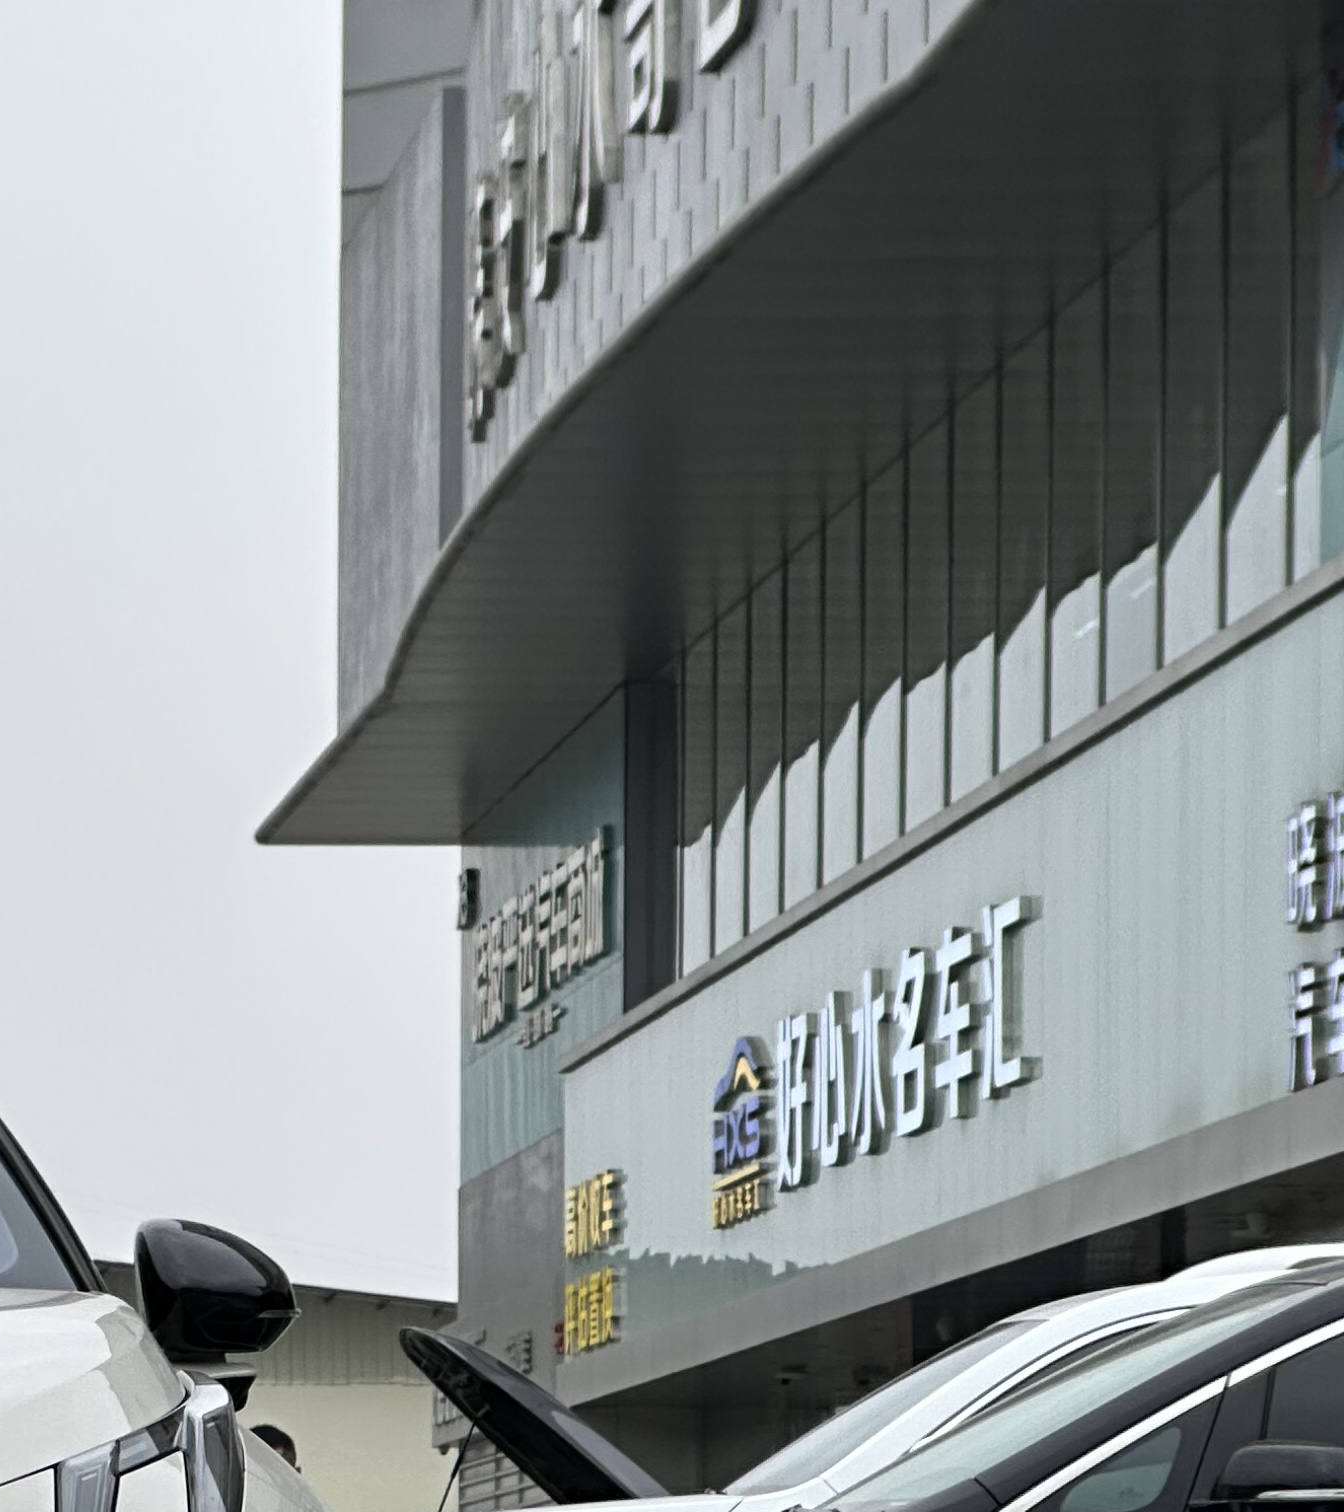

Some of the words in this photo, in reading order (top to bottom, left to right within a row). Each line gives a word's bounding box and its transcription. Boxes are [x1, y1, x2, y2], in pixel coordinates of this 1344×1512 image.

[713, 1097, 761, 1173] HXS
[775, 895, 1024, 1190] 好心水名车汇
